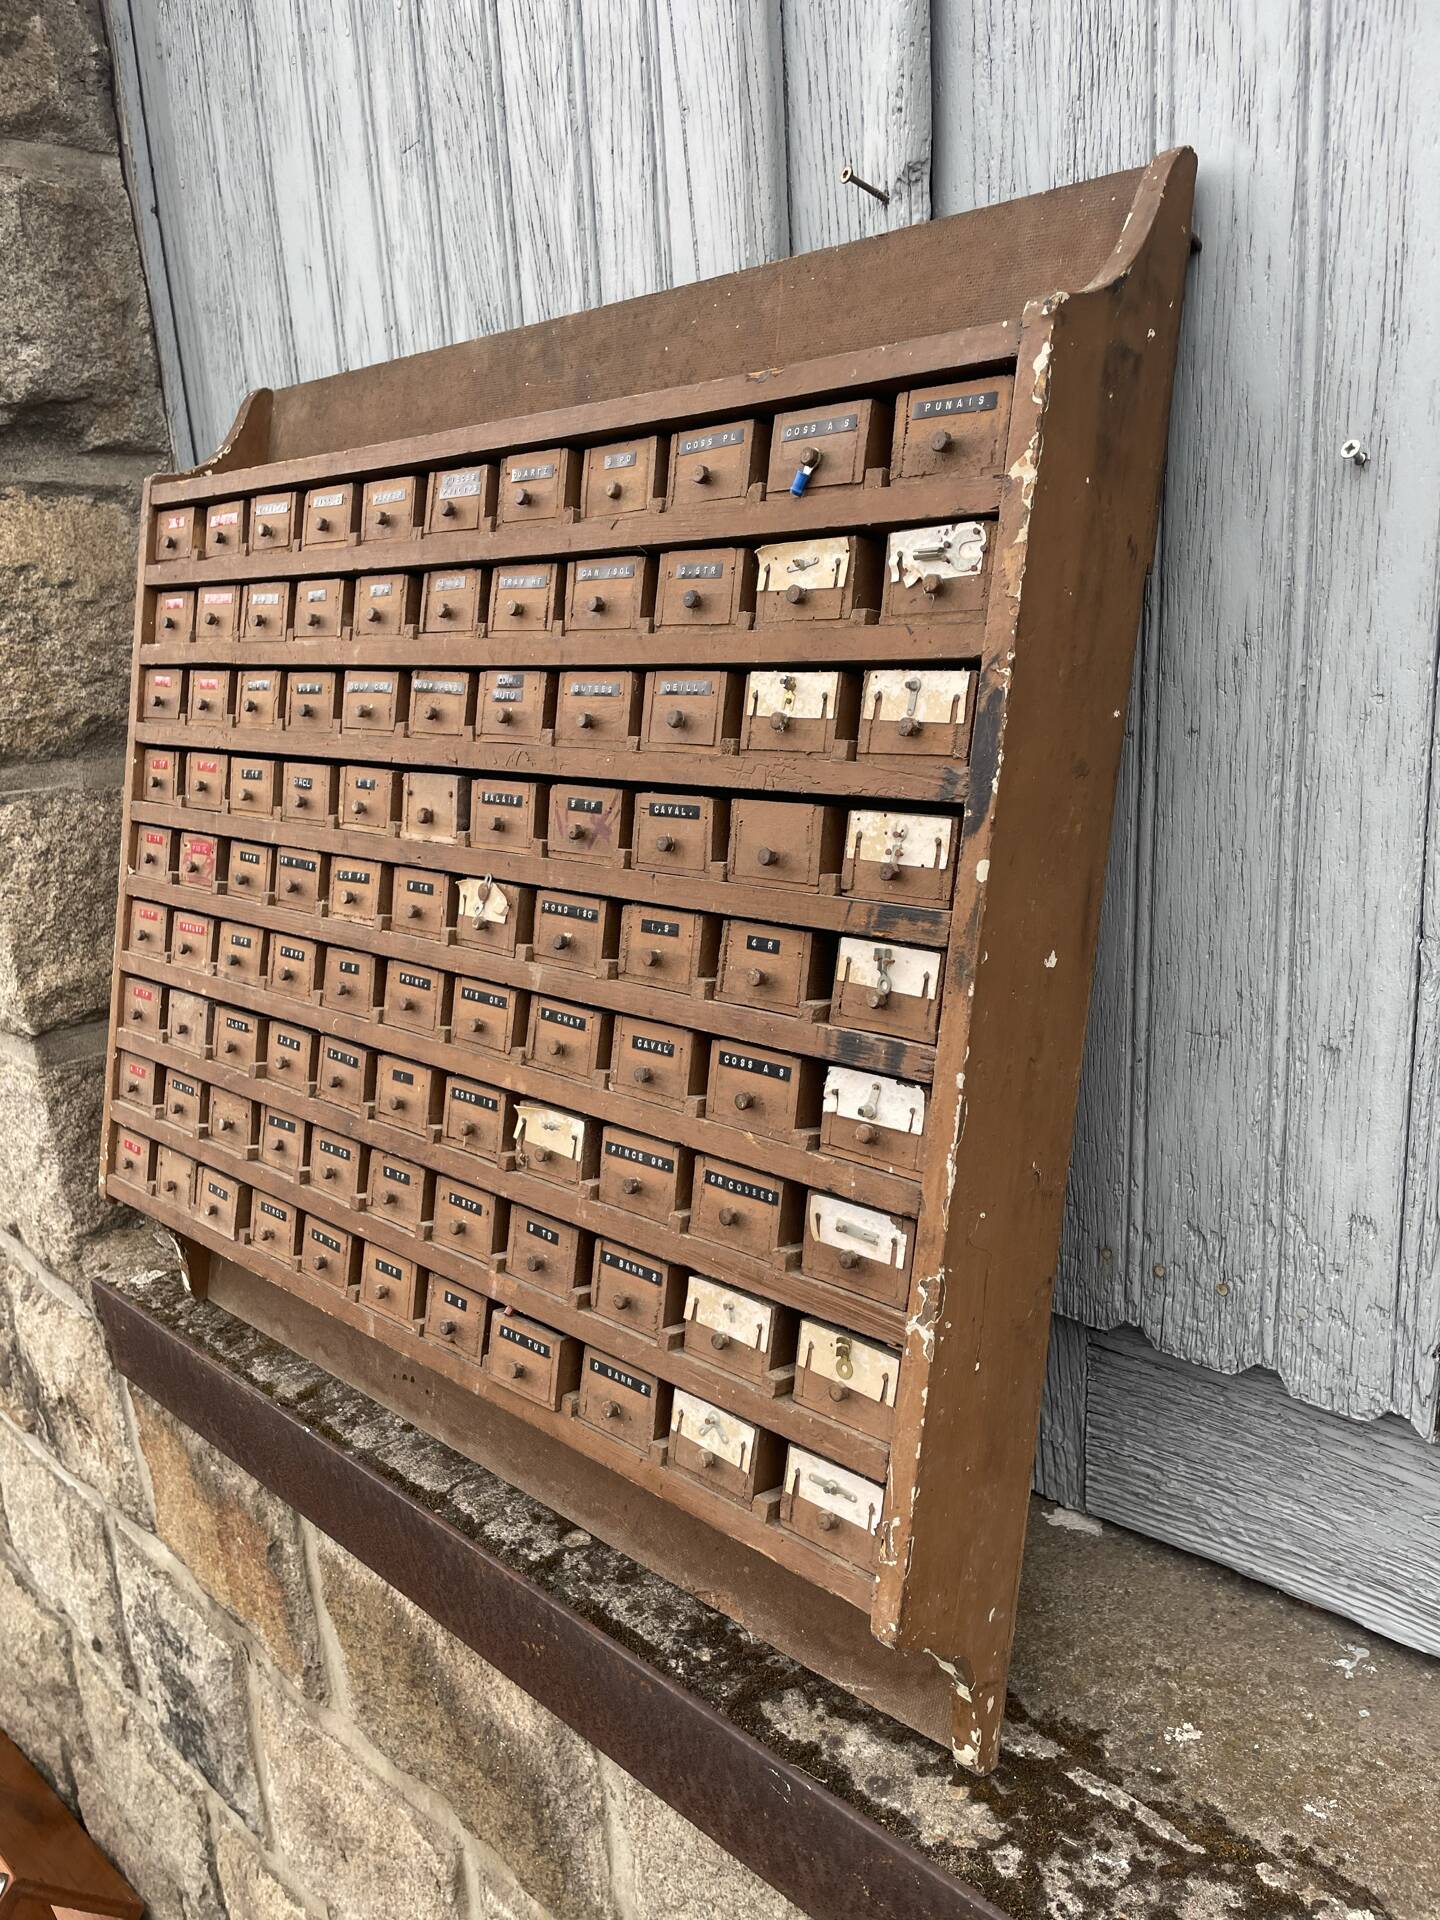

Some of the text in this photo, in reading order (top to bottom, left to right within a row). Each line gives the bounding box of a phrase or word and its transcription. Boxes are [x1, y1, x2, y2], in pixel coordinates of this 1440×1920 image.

[923, 394, 984, 413] PUNAIS
[785, 423, 816, 438] COSS
[686, 437, 712, 450] COSS
[723, 1052, 752, 1070] COSS
[610, 1144, 643, 1162] PINCE
